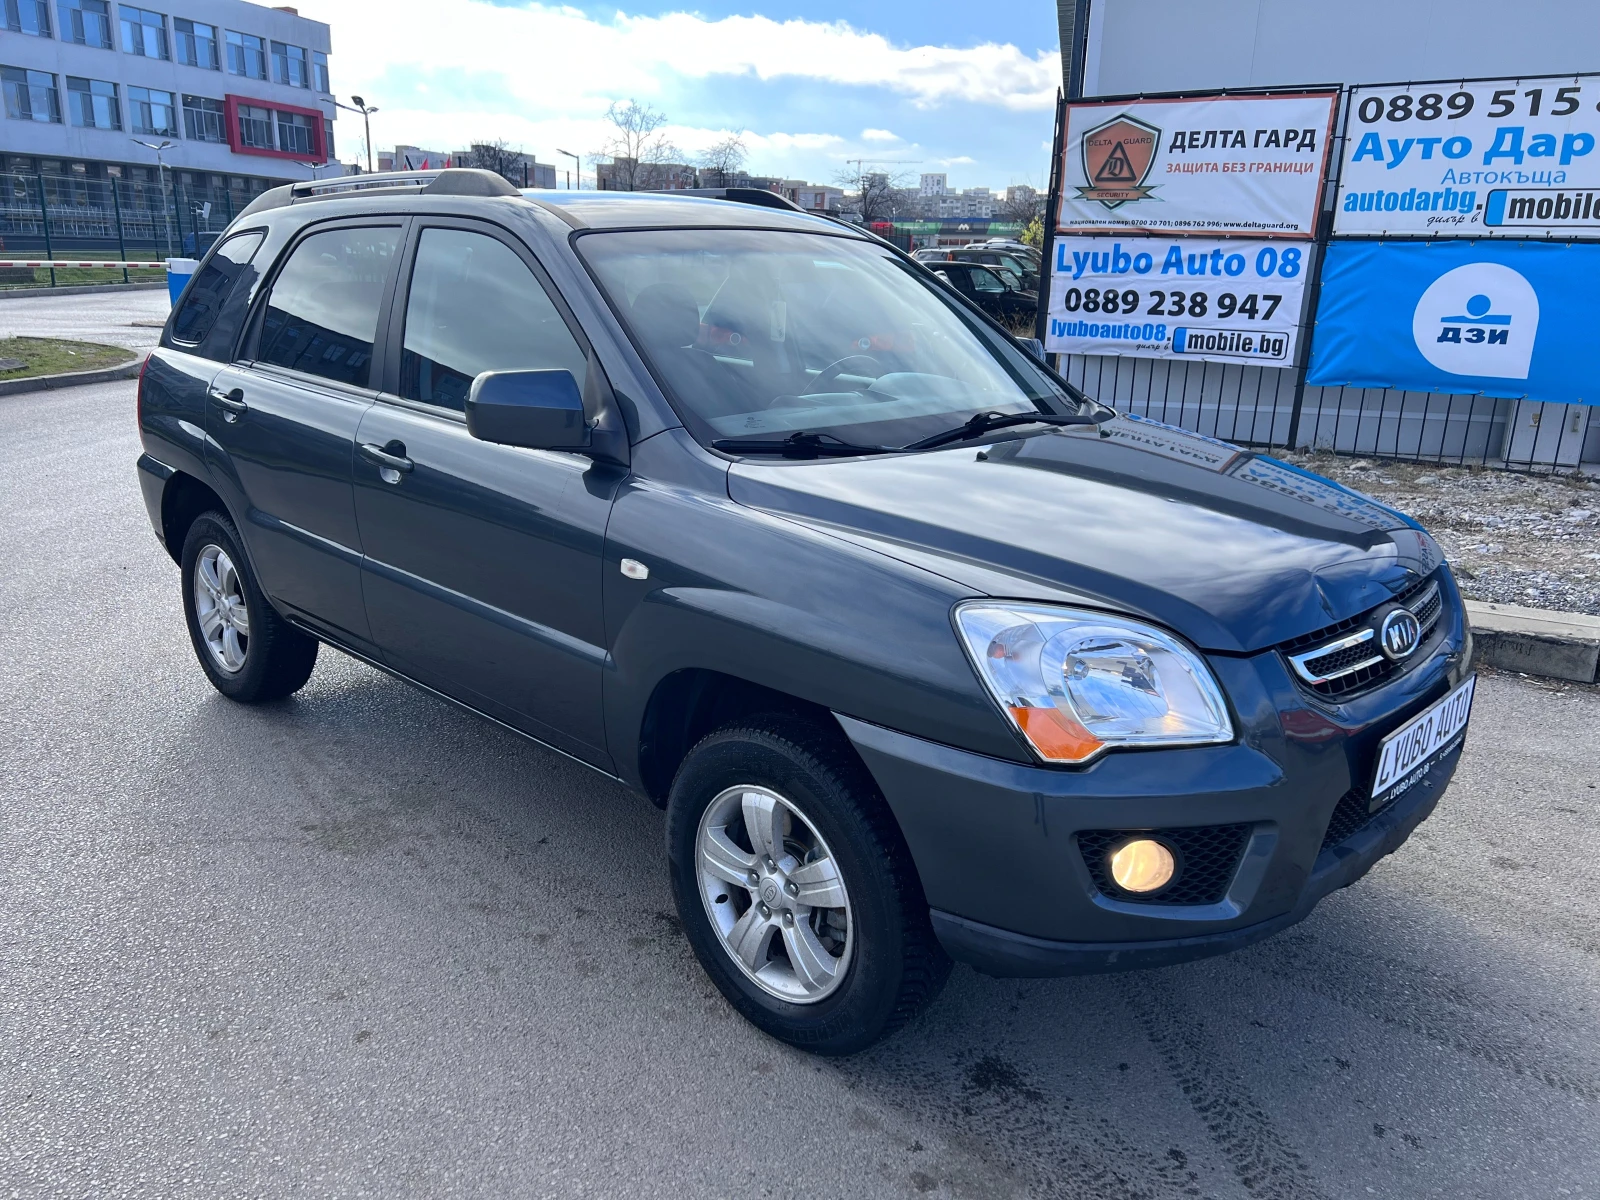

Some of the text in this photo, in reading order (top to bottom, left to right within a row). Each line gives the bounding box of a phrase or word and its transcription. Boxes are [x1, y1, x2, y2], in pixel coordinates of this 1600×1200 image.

[1358, 86, 1581, 123] 0889 515
[1088, 137, 1152, 147] DELTA GUARD
[1168, 128, 1317, 153] ДЕЛТА ГАРД
[1351, 126, 1596, 170] Ауто Дар
[1166, 162, 1314, 175] ЗАЩИТА БЕЗ ГРАНИЦИ
[1440, 168, 1567, 187] Автокъща
[1223, 221, 1299, 230] www.deltaguard.org
[1056, 243, 1302, 280] Lyubo Auto 08
[1064, 287, 1283, 321] 0889 238 947
[1186, 332, 1284, 356] mobile.bg
[1436, 326, 1510, 345] ДЗИ
[1387, 618, 1416, 652] KIA
[1378, 715, 1434, 788] LYUBO
[1433, 685, 1470, 747] AUTO
[1390, 777, 1410, 801] LYUBO
[1408, 766, 1424, 788] AUTO
